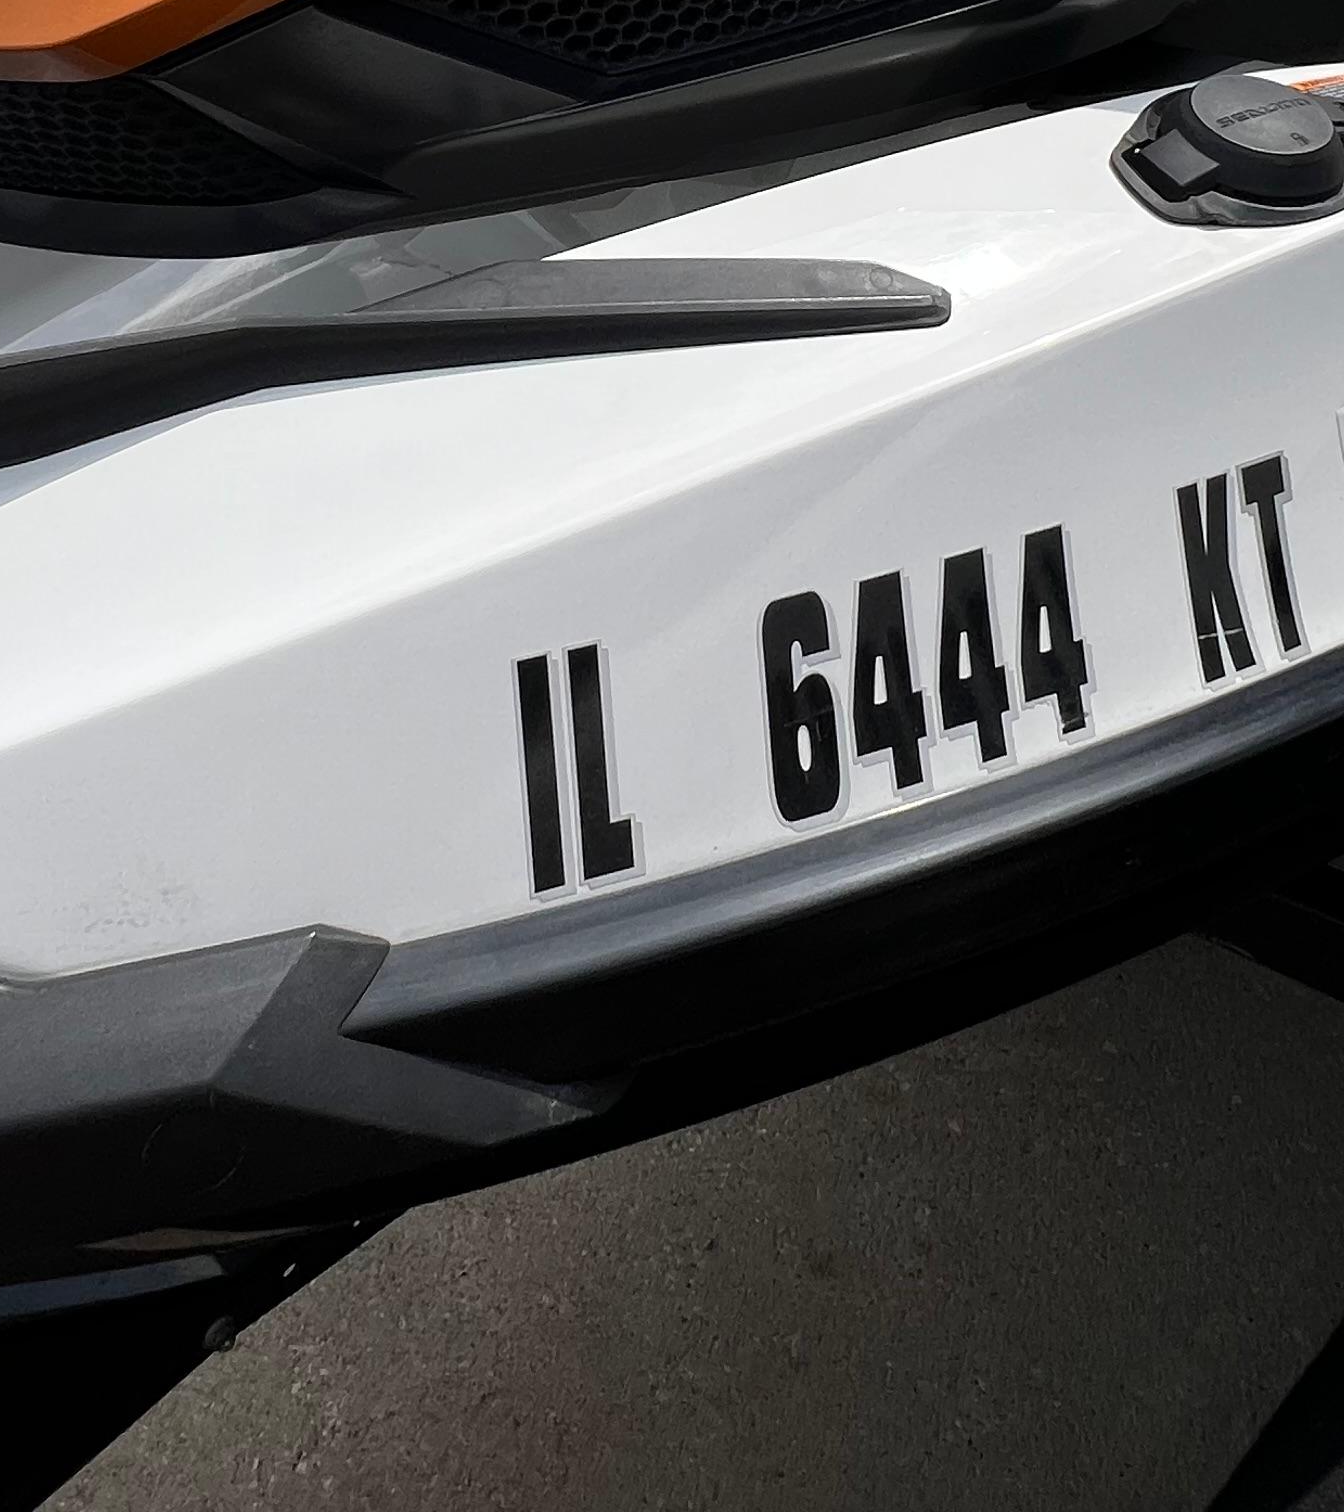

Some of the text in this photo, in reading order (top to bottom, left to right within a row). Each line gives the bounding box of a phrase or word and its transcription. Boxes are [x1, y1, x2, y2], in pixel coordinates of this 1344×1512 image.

[515, 455, 1302, 893] IL 6444 KT
